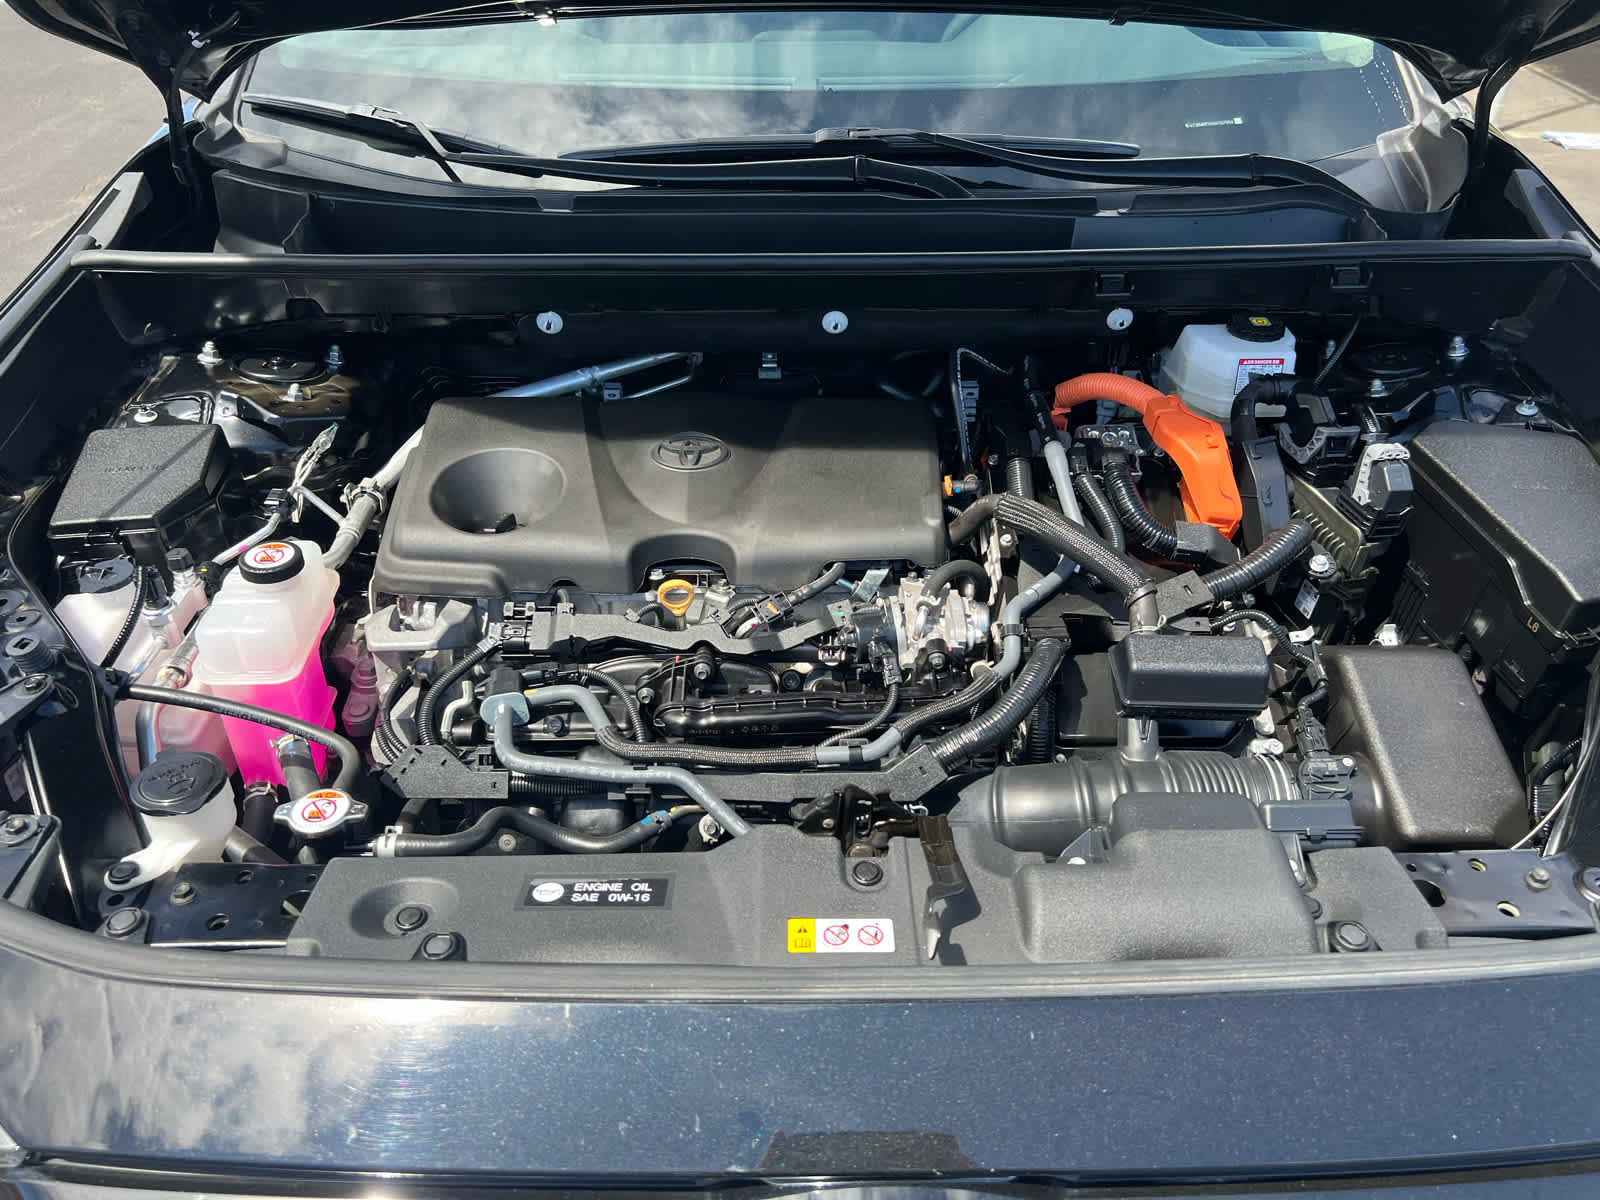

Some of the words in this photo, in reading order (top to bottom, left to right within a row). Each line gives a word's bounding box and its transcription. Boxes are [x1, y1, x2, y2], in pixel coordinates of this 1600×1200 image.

[574, 882, 623, 892] ENGINE
[631, 882, 653, 892] OIL
[570, 892, 599, 902] SAE
[608, 892, 650, 902] 0W-16
